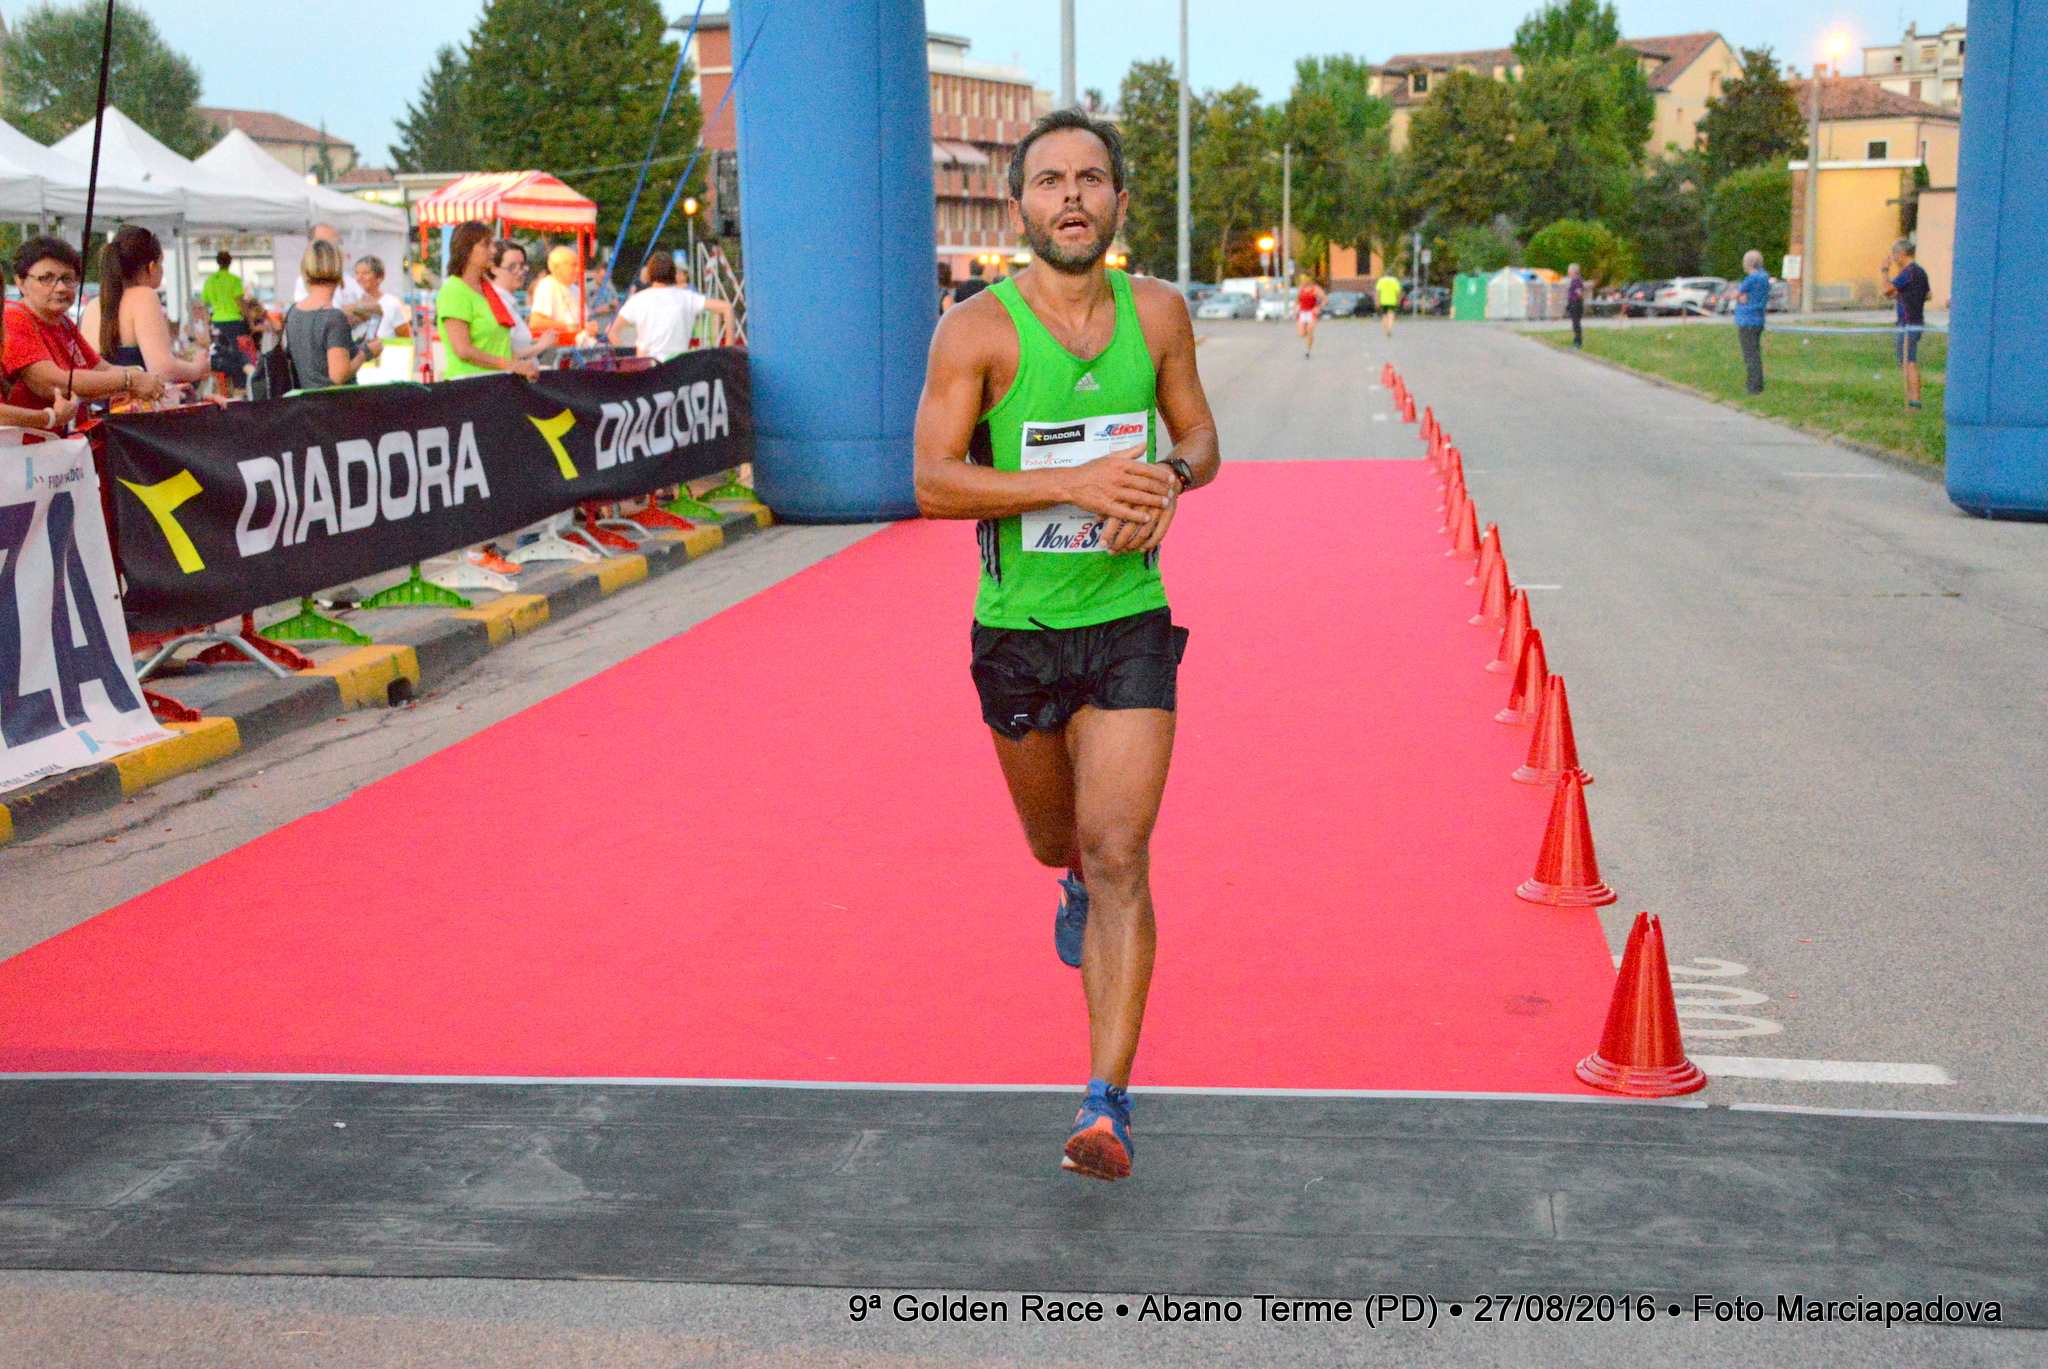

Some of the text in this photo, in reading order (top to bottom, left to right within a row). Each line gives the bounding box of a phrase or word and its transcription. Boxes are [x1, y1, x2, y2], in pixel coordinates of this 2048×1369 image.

[595, 378, 729, 470] DIADORA
[1043, 430, 1082, 441] DIADORA
[235, 421, 491, 558] DIADORA
